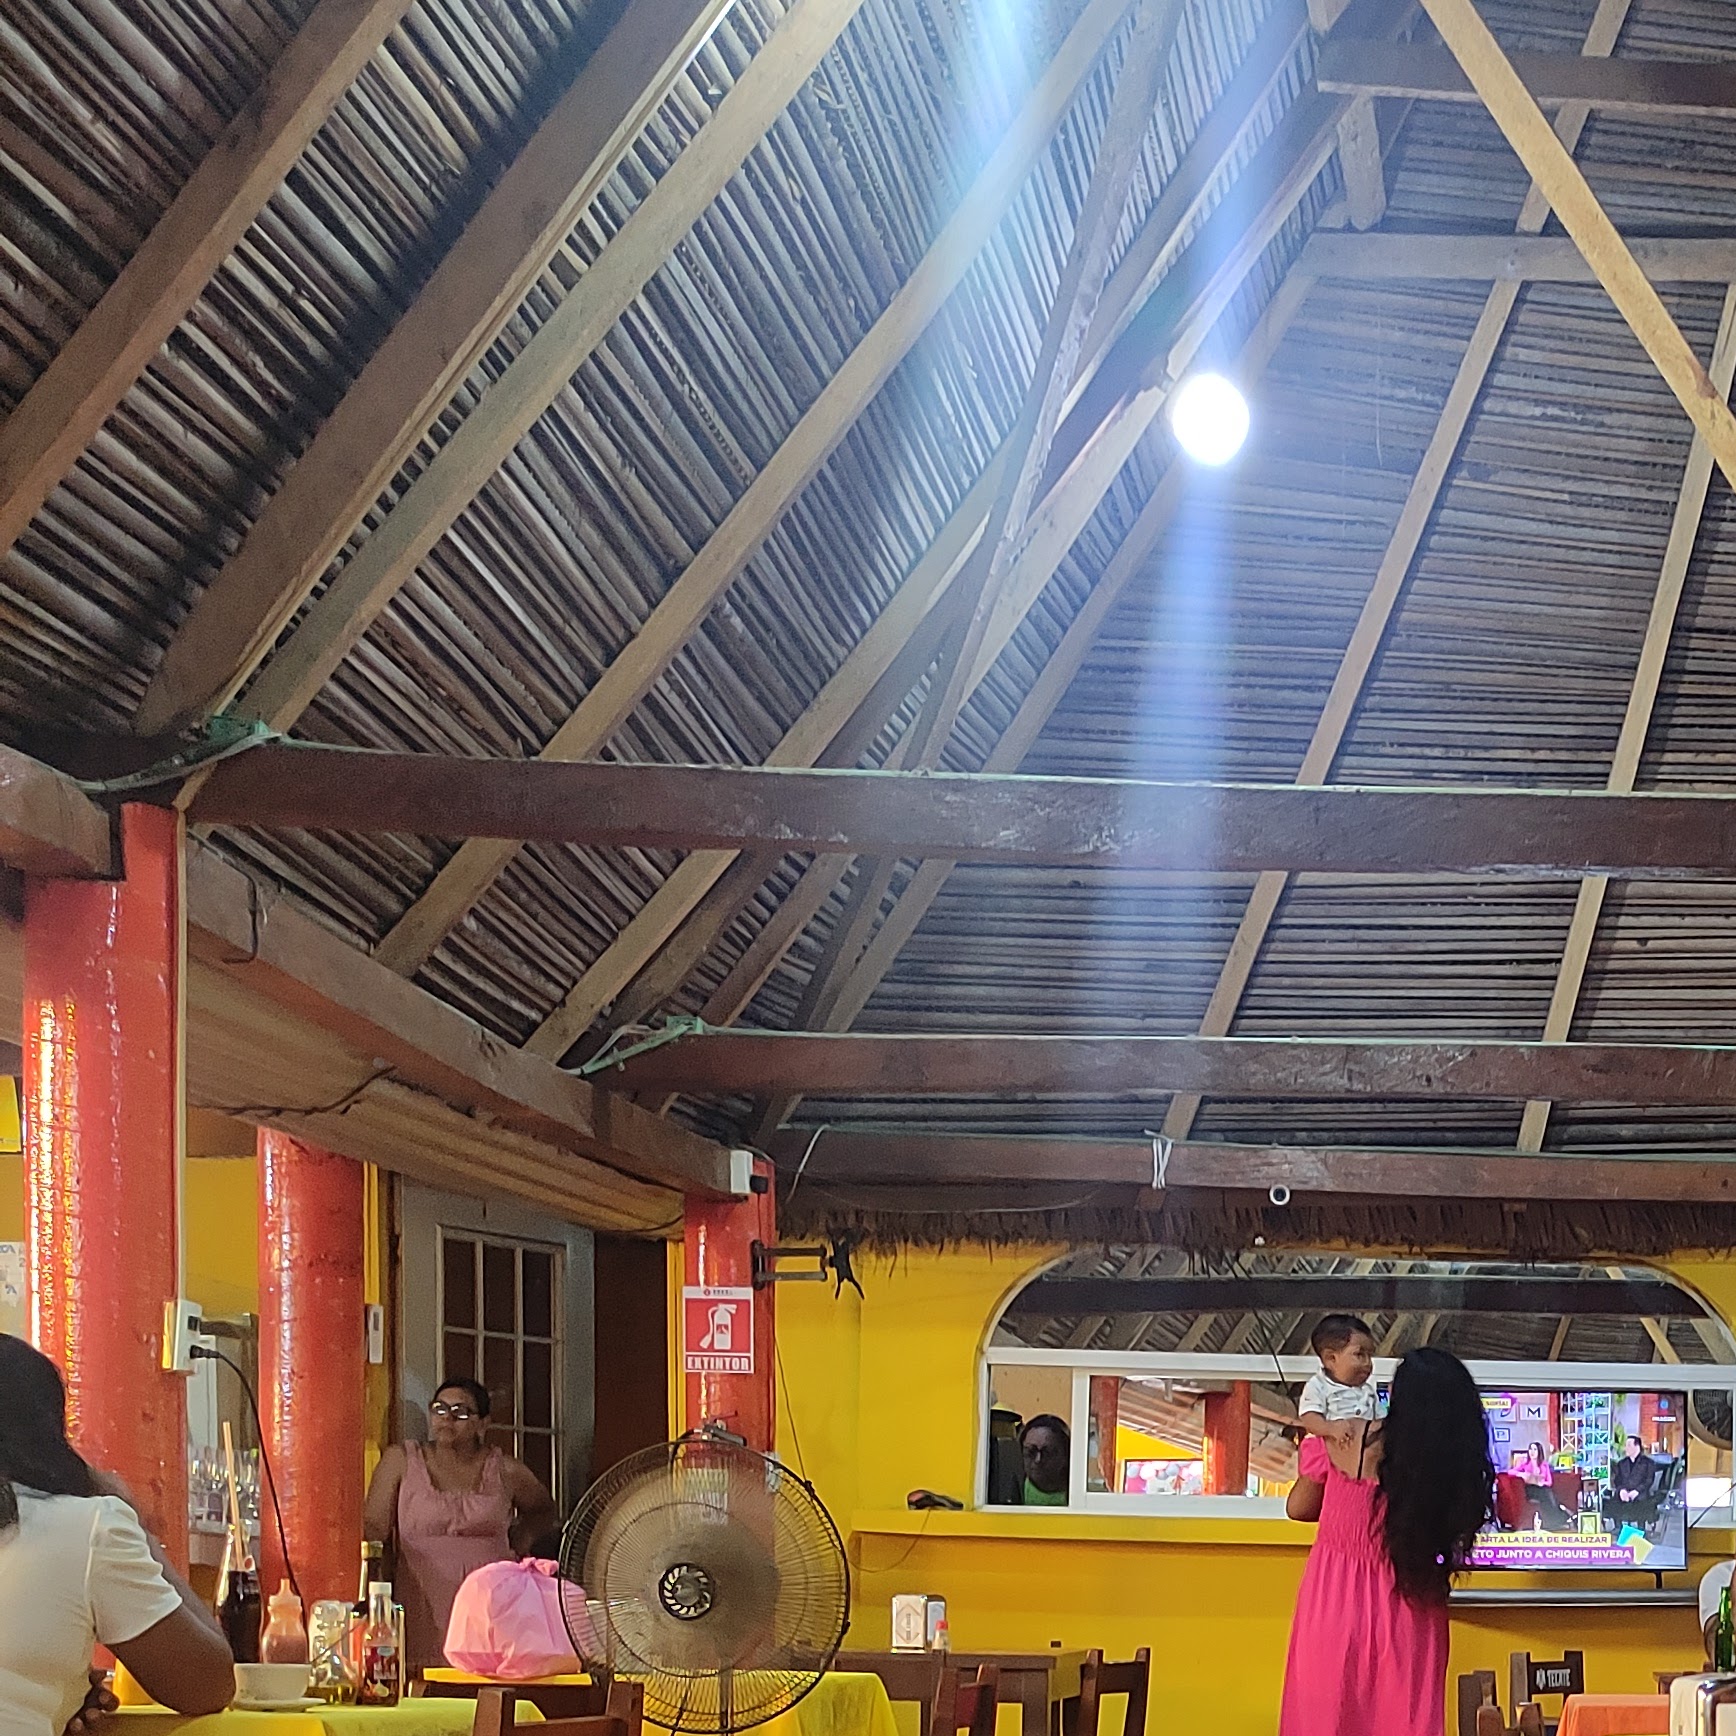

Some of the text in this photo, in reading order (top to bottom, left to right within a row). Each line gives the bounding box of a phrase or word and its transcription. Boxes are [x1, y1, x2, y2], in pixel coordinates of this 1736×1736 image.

[687, 1356, 749, 1370] EXTINTOR
[1496, 1549, 1532, 1558] JUNTO
[1535, 1549, 1543, 1558] A
[1545, 1549, 1589, 1558] CHIQUIS
[1591, 1549, 1632, 1558] RIVERA
[1547, 1669, 1570, 1687] TECATE
